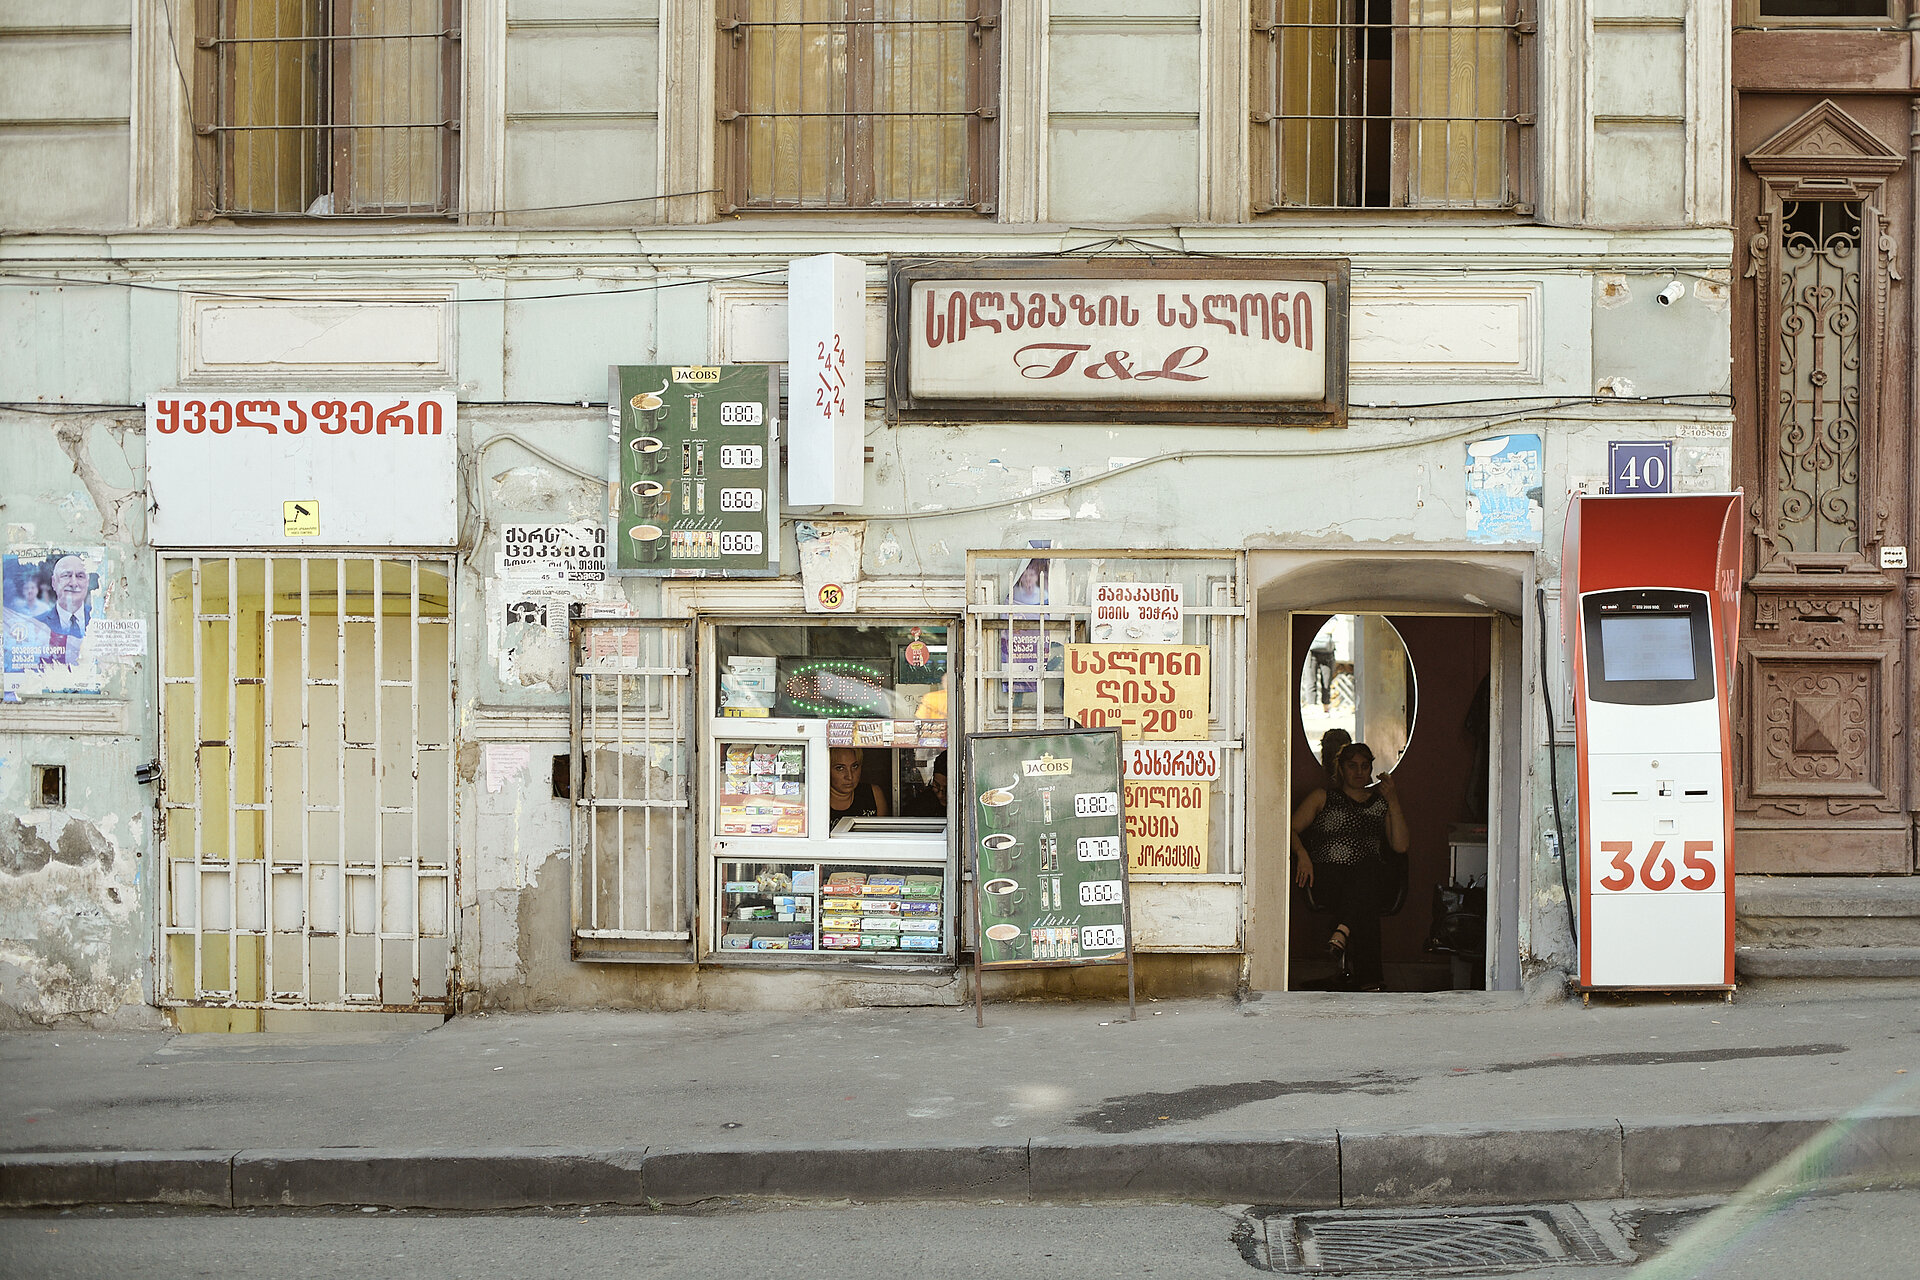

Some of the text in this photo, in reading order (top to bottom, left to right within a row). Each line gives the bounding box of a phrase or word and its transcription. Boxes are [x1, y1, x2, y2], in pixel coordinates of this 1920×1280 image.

[925, 289, 1314, 352] სილამაზის სალონი
[1013, 342, 1210, 382] T&L
[675, 370, 718, 380] JACOBS
[156, 400, 443, 435] ყველაფერი
[1619, 456, 1665, 488] 40
[1098, 588, 1179, 602] მამაკაცის
[1098, 606, 1179, 620] თმის შეჭრა
[1071, 650, 1201, 676] სალონი
[787, 675, 884, 700] OPEN
[1096, 680, 1176, 704] ღიაა
[1026, 761, 1070, 773] JACOBS
[1133, 750, 1216, 776] გახვრეტა
[1125, 786, 1201, 808] ტოლოგი
[1137, 845, 1201, 867] კორექცია
[1599, 840, 1716, 891] 365
